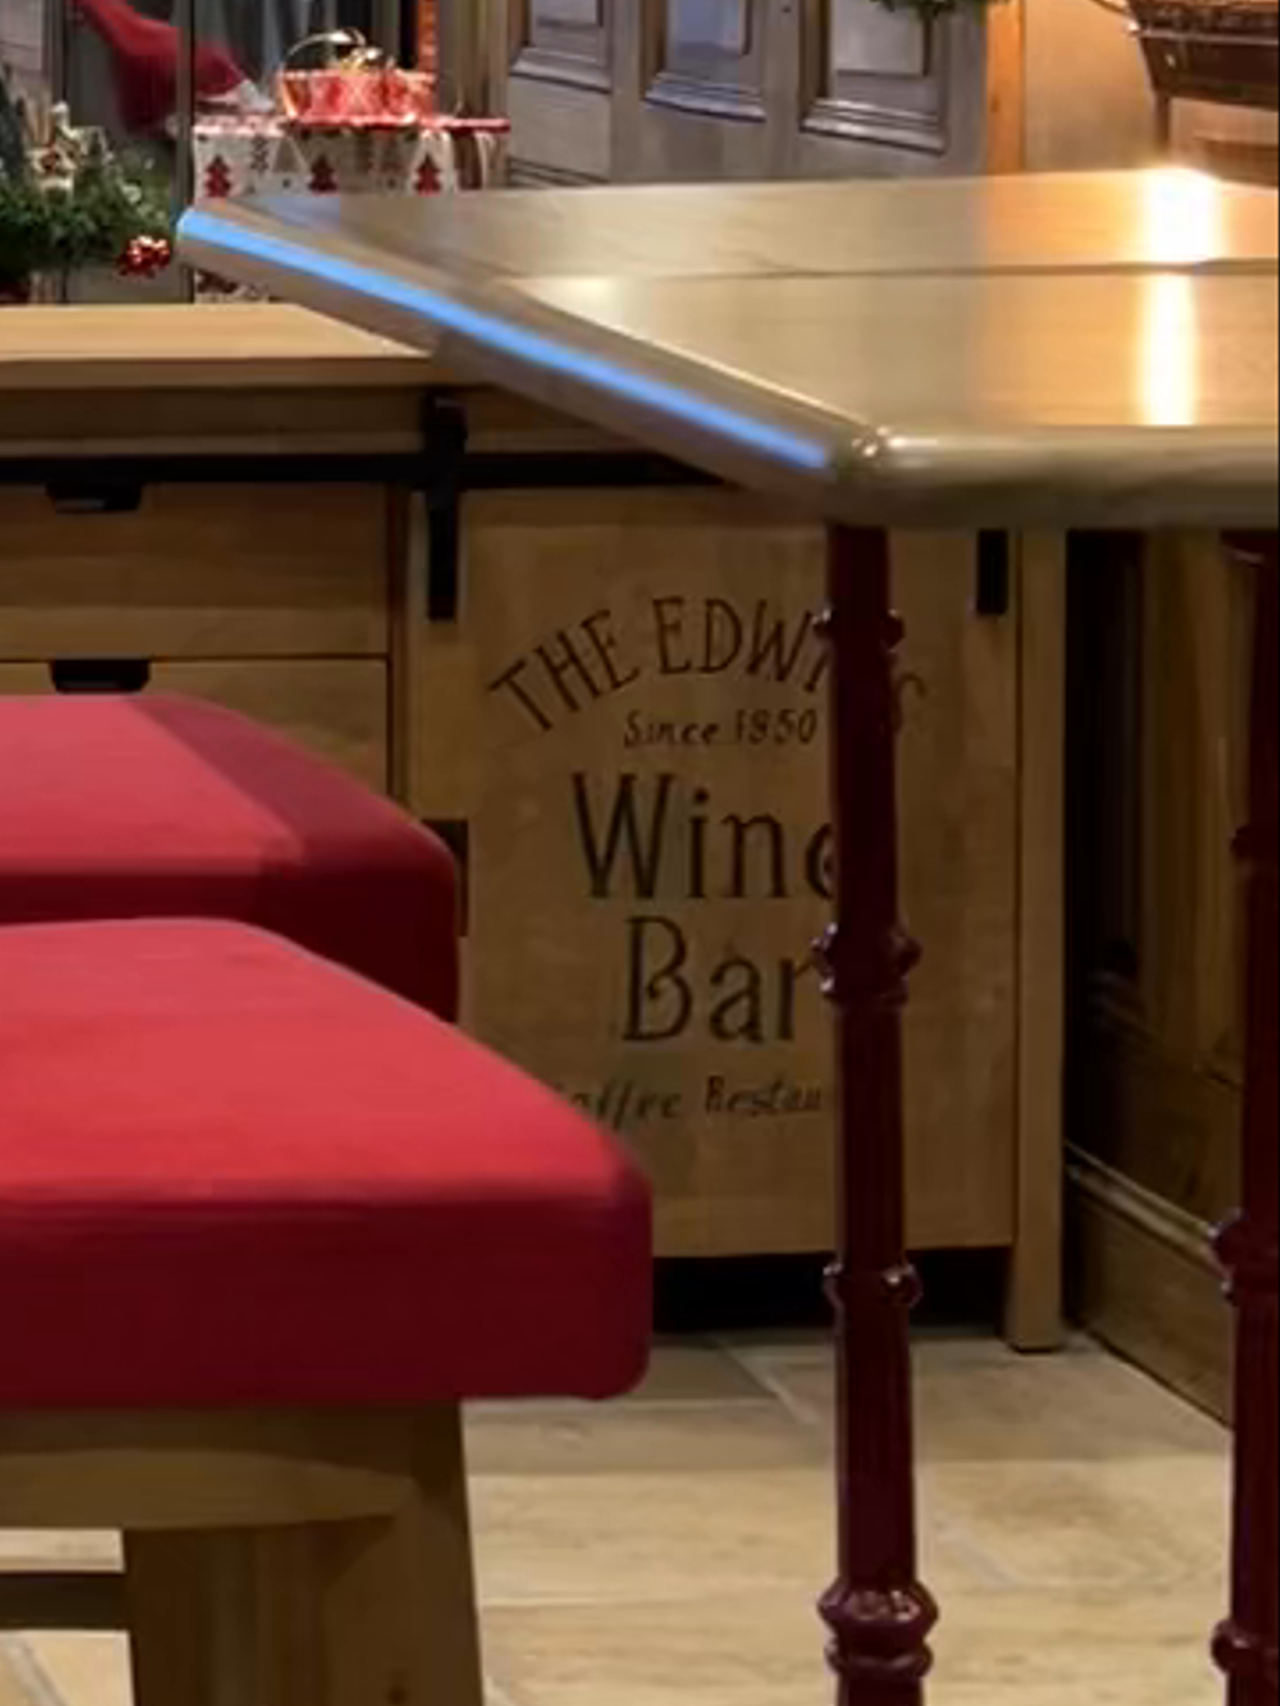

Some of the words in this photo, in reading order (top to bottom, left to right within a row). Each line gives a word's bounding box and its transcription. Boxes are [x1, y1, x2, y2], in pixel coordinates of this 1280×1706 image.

[489, 609, 639, 730] THE
[624, 710, 718, 747] Since
[621, 916, 815, 1043] Bar
